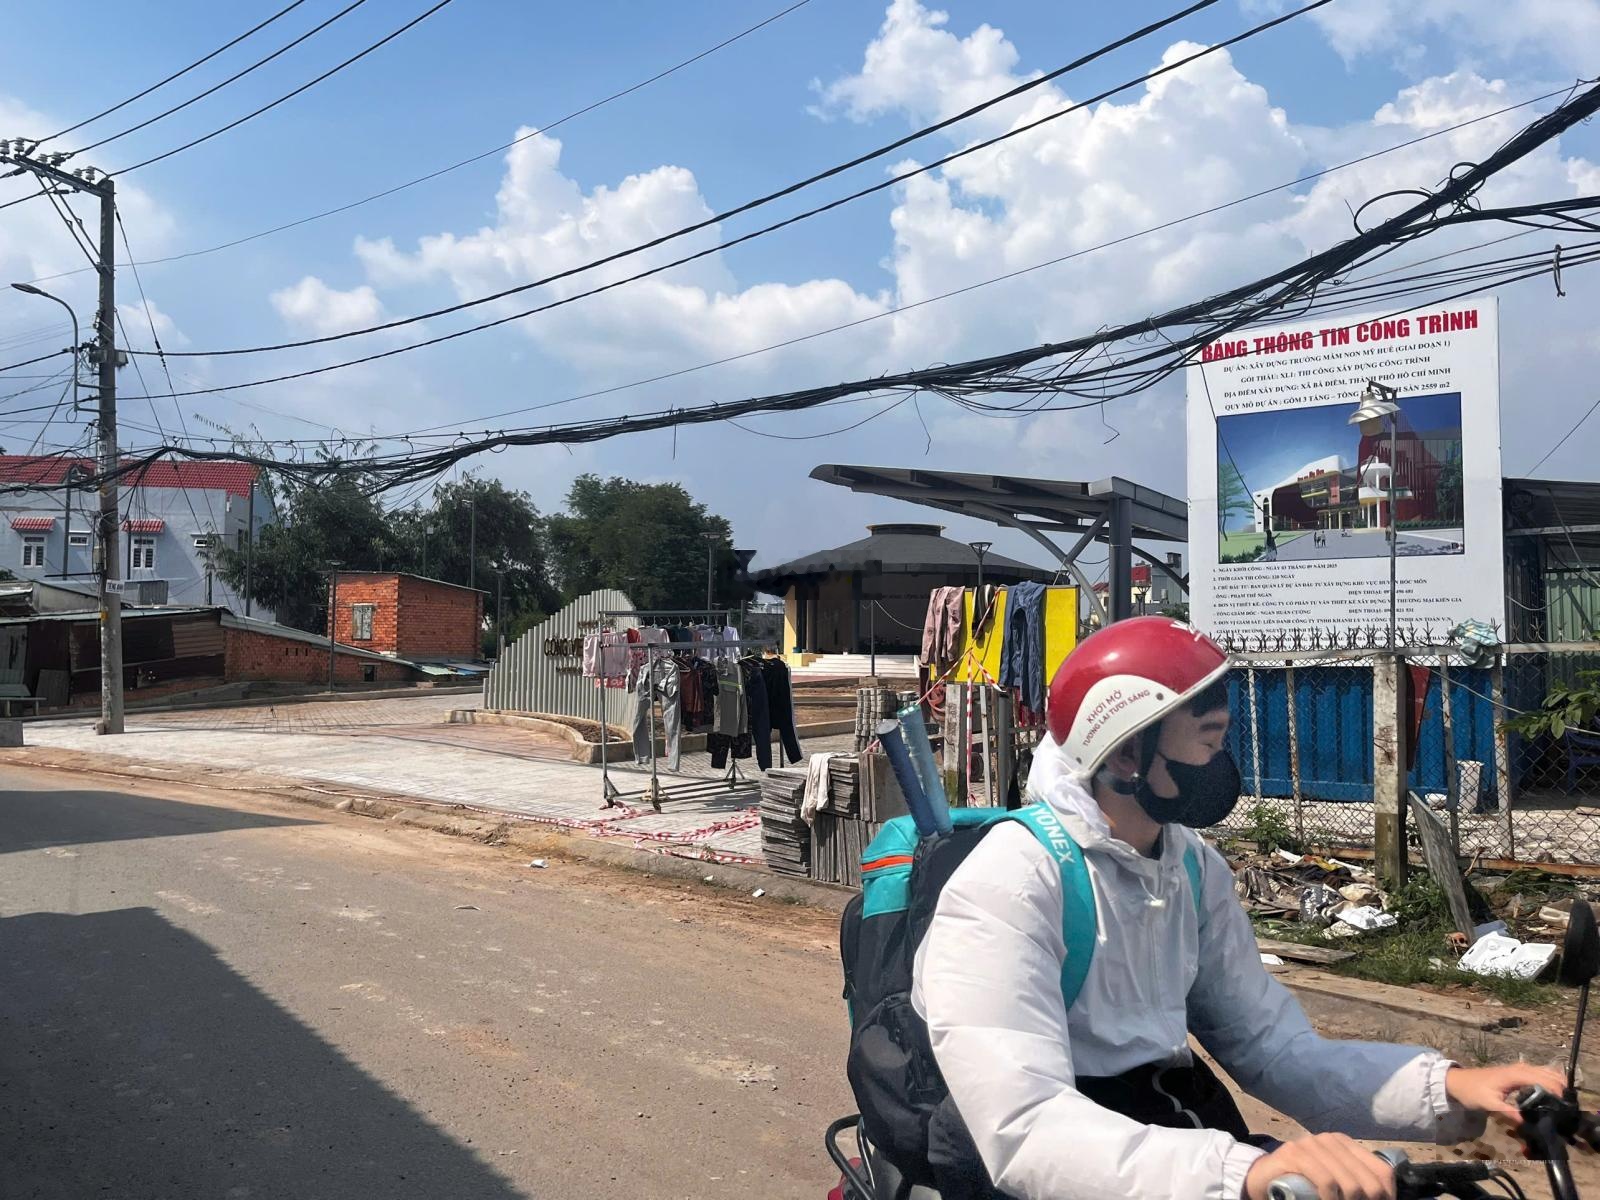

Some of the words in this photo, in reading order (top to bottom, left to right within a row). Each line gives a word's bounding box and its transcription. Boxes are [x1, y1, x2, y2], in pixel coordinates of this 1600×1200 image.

[1202, 338, 1248, 362] BẢNG
[1253, 332, 1314, 356] THÔNG
[1320, 326, 1350, 348] TIN
[1356, 318, 1410, 342] CÔNG
[1416, 310, 1478, 334] TRÌNH
[1241, 375, 1254, 383] GÓI
[1312, 366, 1334, 375] CÔNG
[1336, 364, 1352, 372] XÂY
[1354, 362, 1378, 372] DỰNG
[1379, 359, 1402, 368] CÔNG
[1405, 356, 1430, 364] TRÌNH
[1250, 361, 1265, 370] XÂY
[1266, 360, 1288, 369] DỰNG
[1290, 355, 1322, 366] TRƯỜNG
[1323, 352, 1342, 361] MẦM
[1362, 348, 1376, 356] MỸ
[1378, 346, 1394, 354] HUẾ
[1396, 344, 1416, 352] (GIAI
[1418, 341, 1442, 350] ĐOẠN
[1224, 390, 1237, 398] ĐỊA
[1238, 388, 1257, 397] ĐIỂM
[1258, 386, 1273, 394] XÂY
[1275, 384, 1299, 394] DỰNG:
[1300, 382, 1312, 390] XÃ
[1349, 376, 1377, 385] THÀNH
[1378, 372, 1396, 382] PHỐ
[1398, 370, 1410, 379] HỒ
[1412, 369, 1426, 378] CHÍ
[1428, 367, 1451, 376] MINH
[1225, 404, 1240, 412] QUY
[1242, 400, 1254, 408] MÔ
[1256, 400, 1267, 408] DỰ
[1268, 398, 1278, 406] ÁN
[1284, 396, 1302, 404] GỒM
[1309, 394, 1330, 402] TẦNG
[1337, 390, 1359, 398] TỔNG
[1403, 384, 1419, 392] SÀN
[1082, 724, 1100, 746] TƯƠNG
[1099, 714, 1110, 725] LAI
[1109, 700, 1128, 715] TƯƠI
[1086, 702, 1106, 724] KHƠI
[1106, 689, 1122, 706] MỞ
[1029, 807, 1076, 864] YONEX
